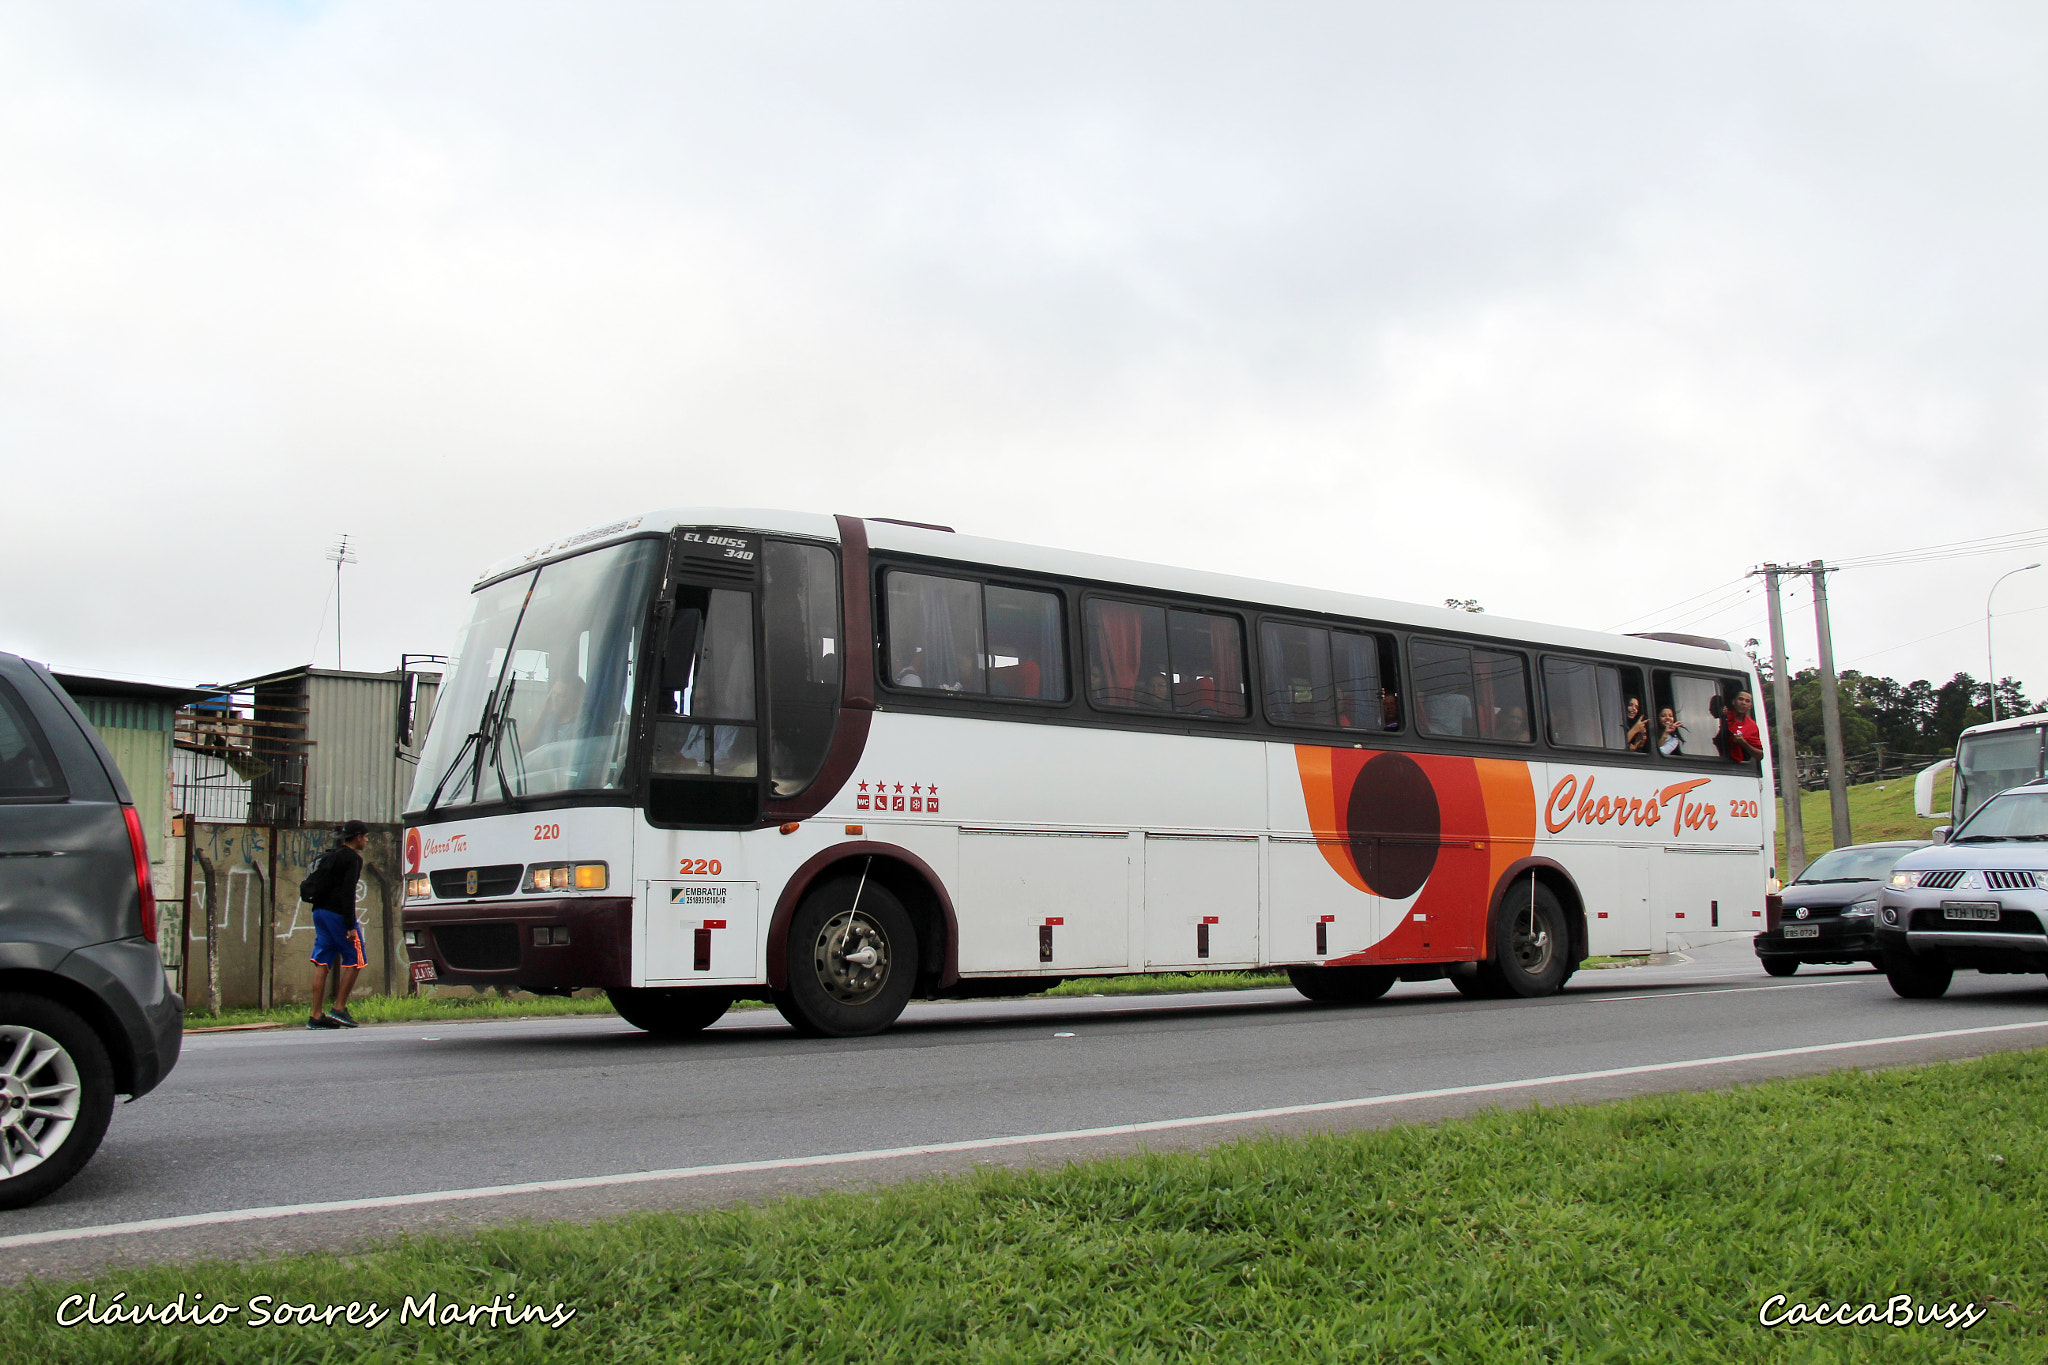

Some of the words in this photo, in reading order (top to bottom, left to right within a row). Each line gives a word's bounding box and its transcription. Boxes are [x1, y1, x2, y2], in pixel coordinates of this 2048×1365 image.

[684, 533, 703, 543] EL
[706, 535, 748, 548] BUSS
[724, 549, 754, 560] 340
[1544, 773, 1661, 834] Chorró
[1659, 777, 1718, 837] Tur
[1729, 799, 1758, 818] 220
[534, 823, 560, 841] 220
[424, 838, 451, 859] Chorró
[450, 834, 467, 853] Tur
[679, 858, 722, 876] 220
[685, 887, 727, 896] EMBRATUR
